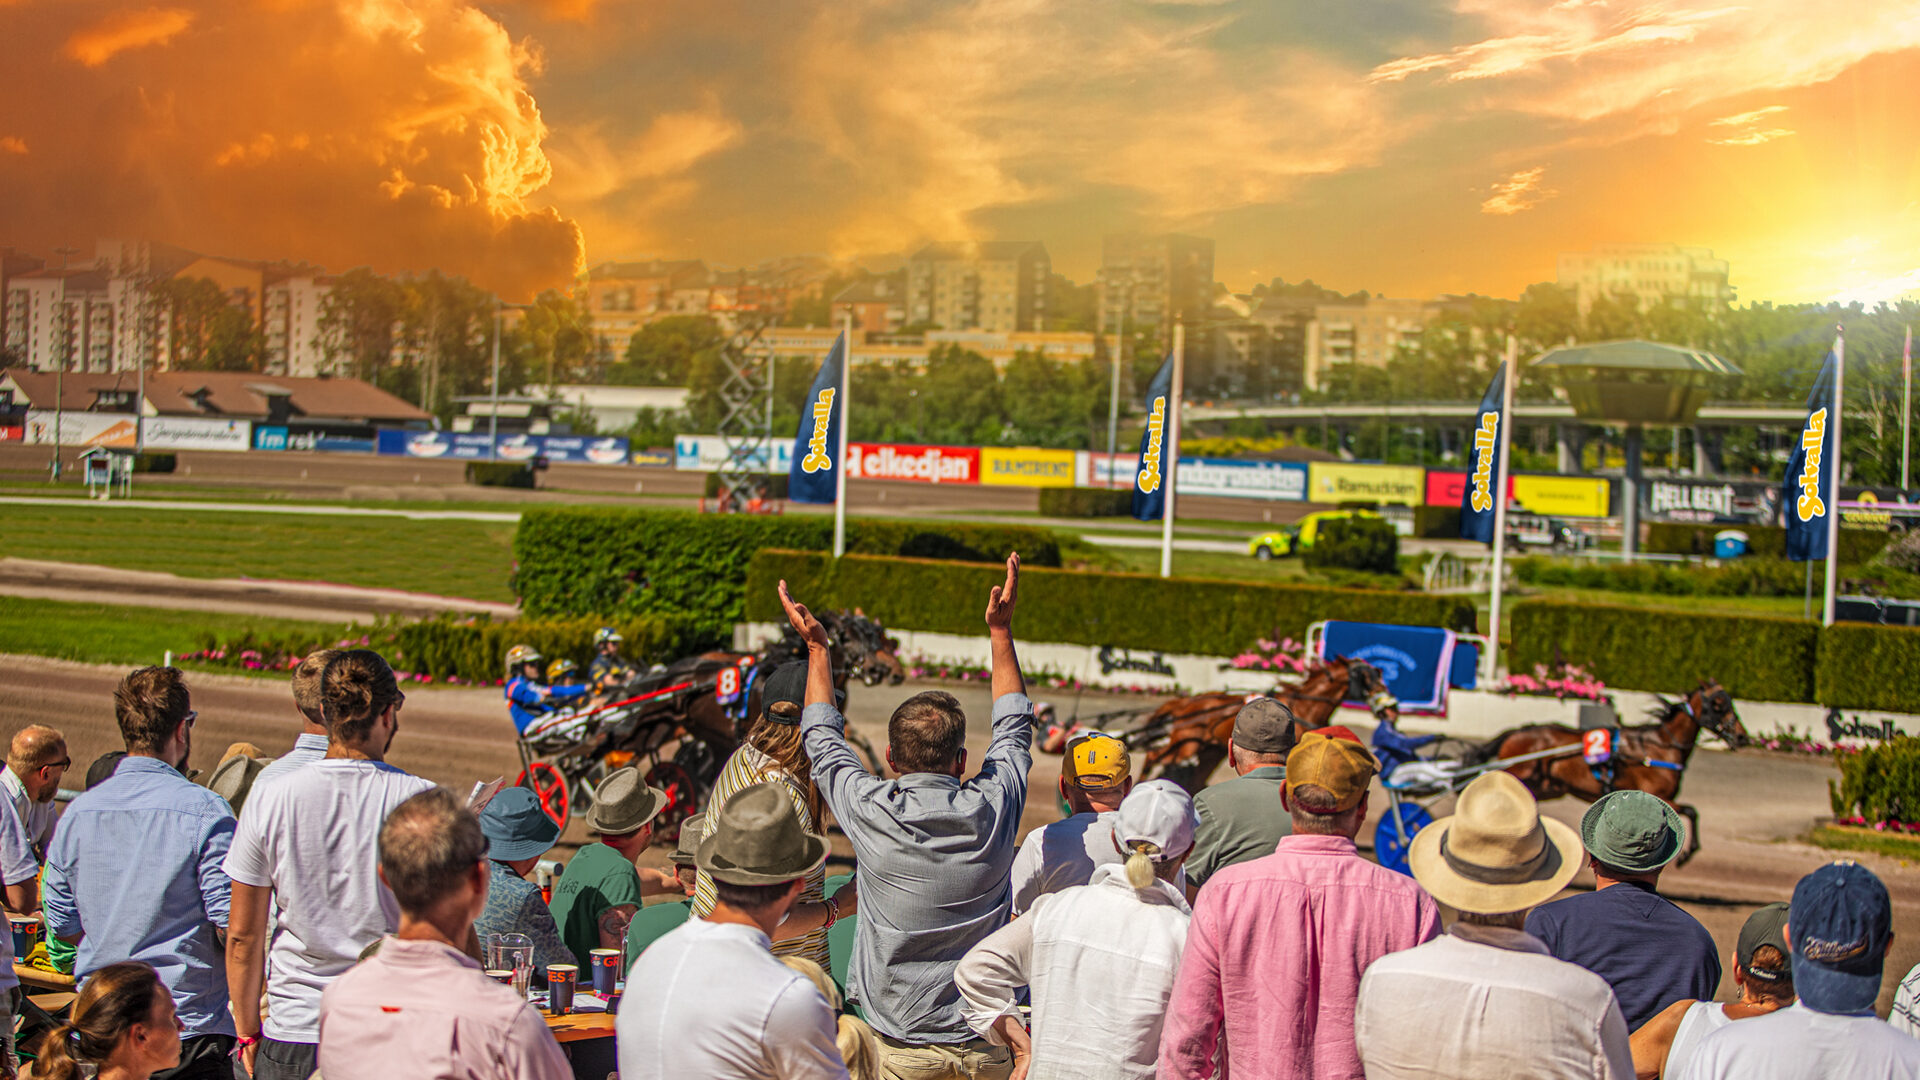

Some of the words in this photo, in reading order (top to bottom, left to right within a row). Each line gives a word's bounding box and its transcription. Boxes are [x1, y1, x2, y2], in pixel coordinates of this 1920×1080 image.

[802, 387, 836, 473] Solvalla
[863, 446, 970, 483] elkedjan
[1138, 396, 1166, 494] Solvalla
[1471, 411, 1499, 513] Solvalla
[1797, 407, 1828, 522] Solvalla
[720, 667, 736, 695] 8
[1587, 729, 1606, 755] 2
